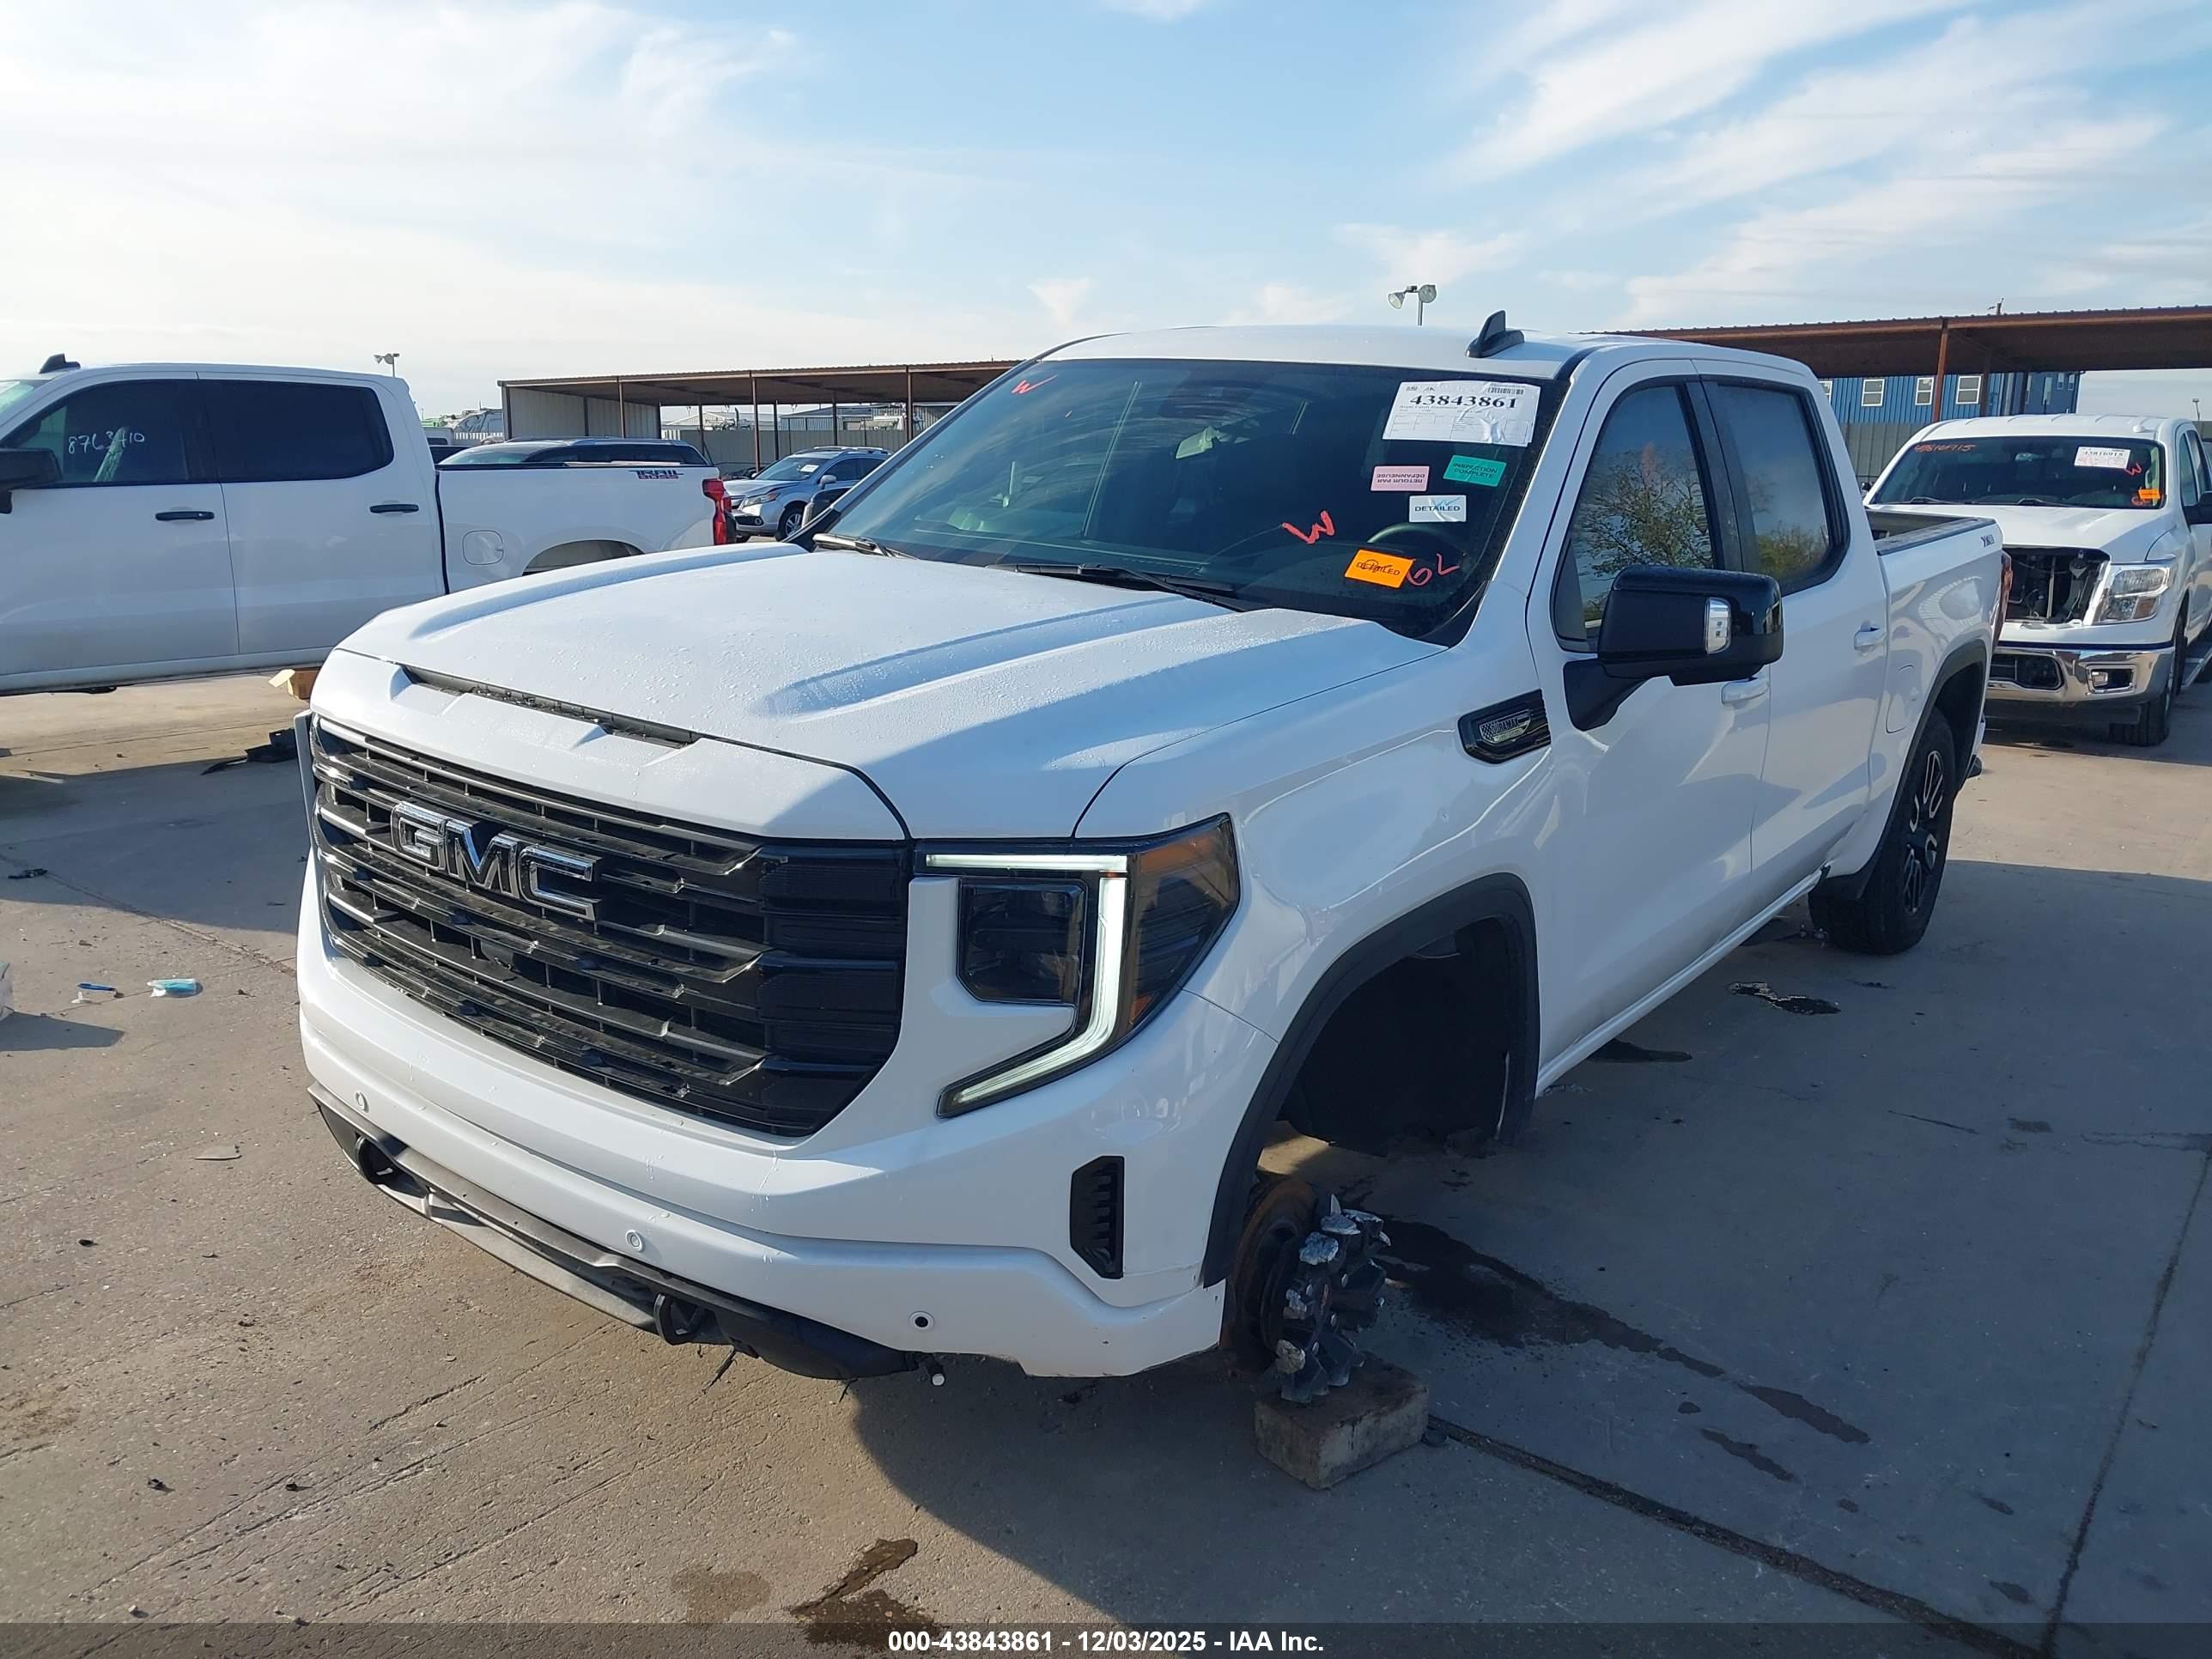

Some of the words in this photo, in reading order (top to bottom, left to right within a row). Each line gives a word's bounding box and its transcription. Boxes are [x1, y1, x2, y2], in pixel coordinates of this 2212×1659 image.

[1410, 394, 1518, 409] 43843861
[1453, 462, 1498, 473] INSPECTION
[1454, 468, 1492, 478] COMPLETE
[1281, 511, 1335, 544] W
[391, 800, 597, 921] GMC
